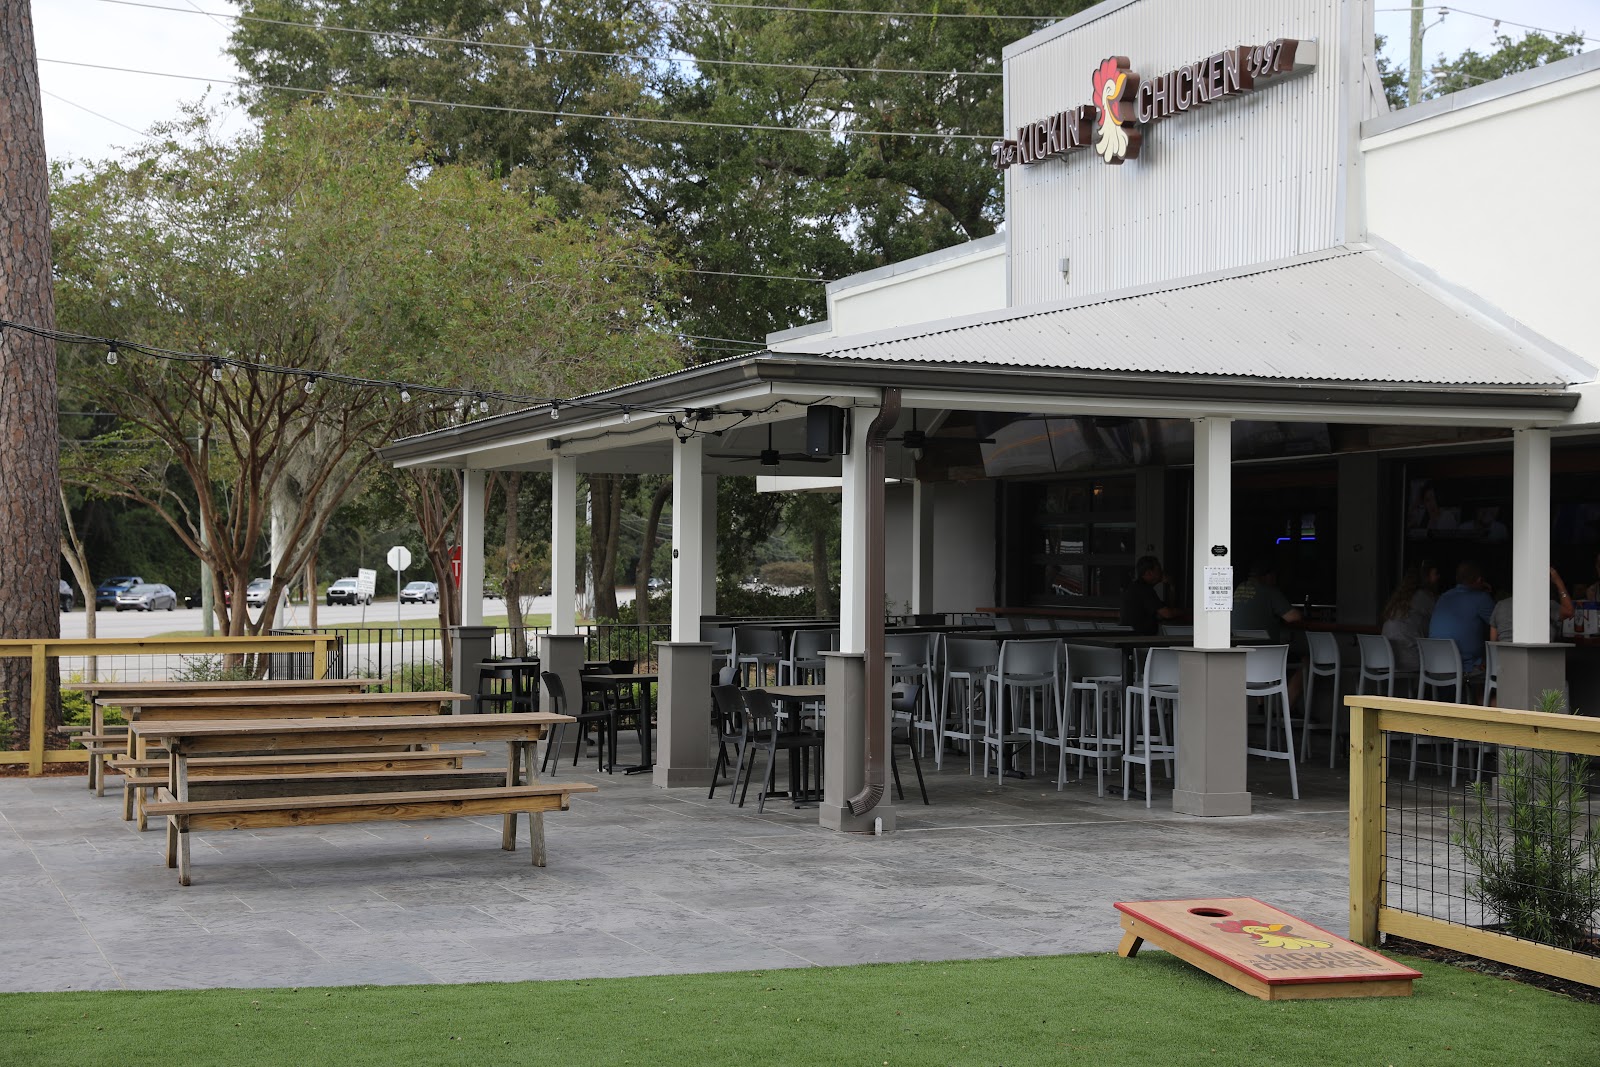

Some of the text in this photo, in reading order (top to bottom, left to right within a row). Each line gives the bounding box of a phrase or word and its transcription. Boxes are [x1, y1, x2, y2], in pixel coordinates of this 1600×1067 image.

[990, 39, 1290, 169] The KICKIN' CHICKEN 1997
[1253, 959, 1383, 971] CHICKEN
